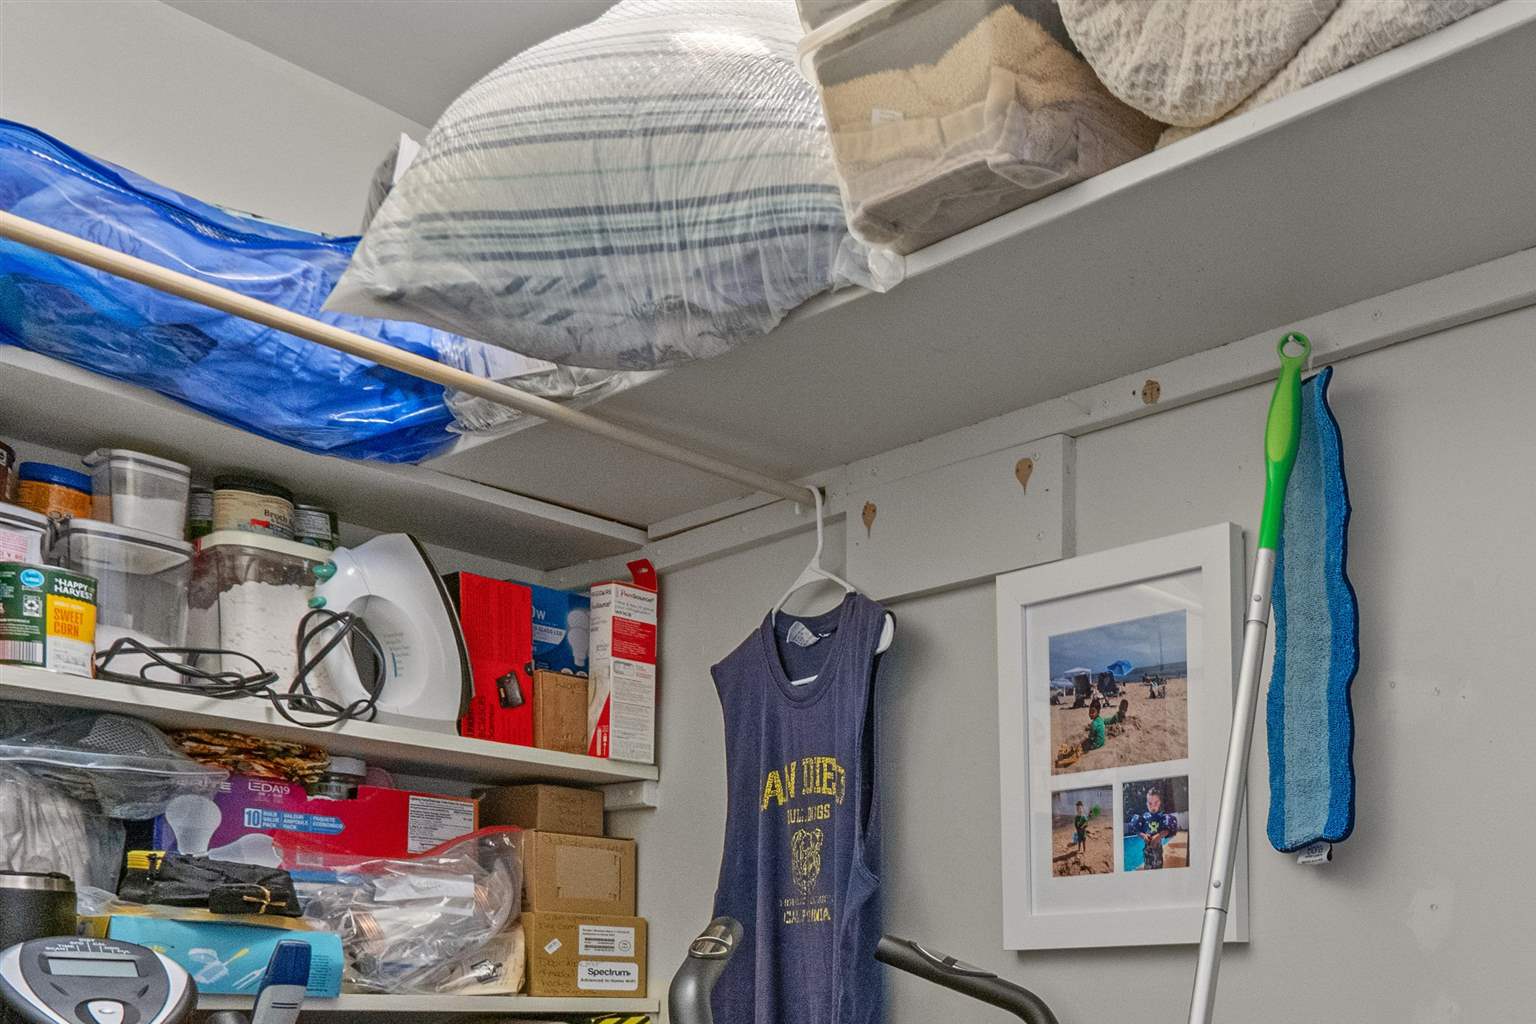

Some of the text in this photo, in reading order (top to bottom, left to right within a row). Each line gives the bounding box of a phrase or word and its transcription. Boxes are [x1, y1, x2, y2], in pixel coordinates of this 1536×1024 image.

[54, 578, 88, 592] HAPPY
[54, 607, 84, 625] SWEET
[54, 621, 79, 639] CORN
[245, 809, 260, 827] 10
[587, 967, 630, 977] Spectrum
